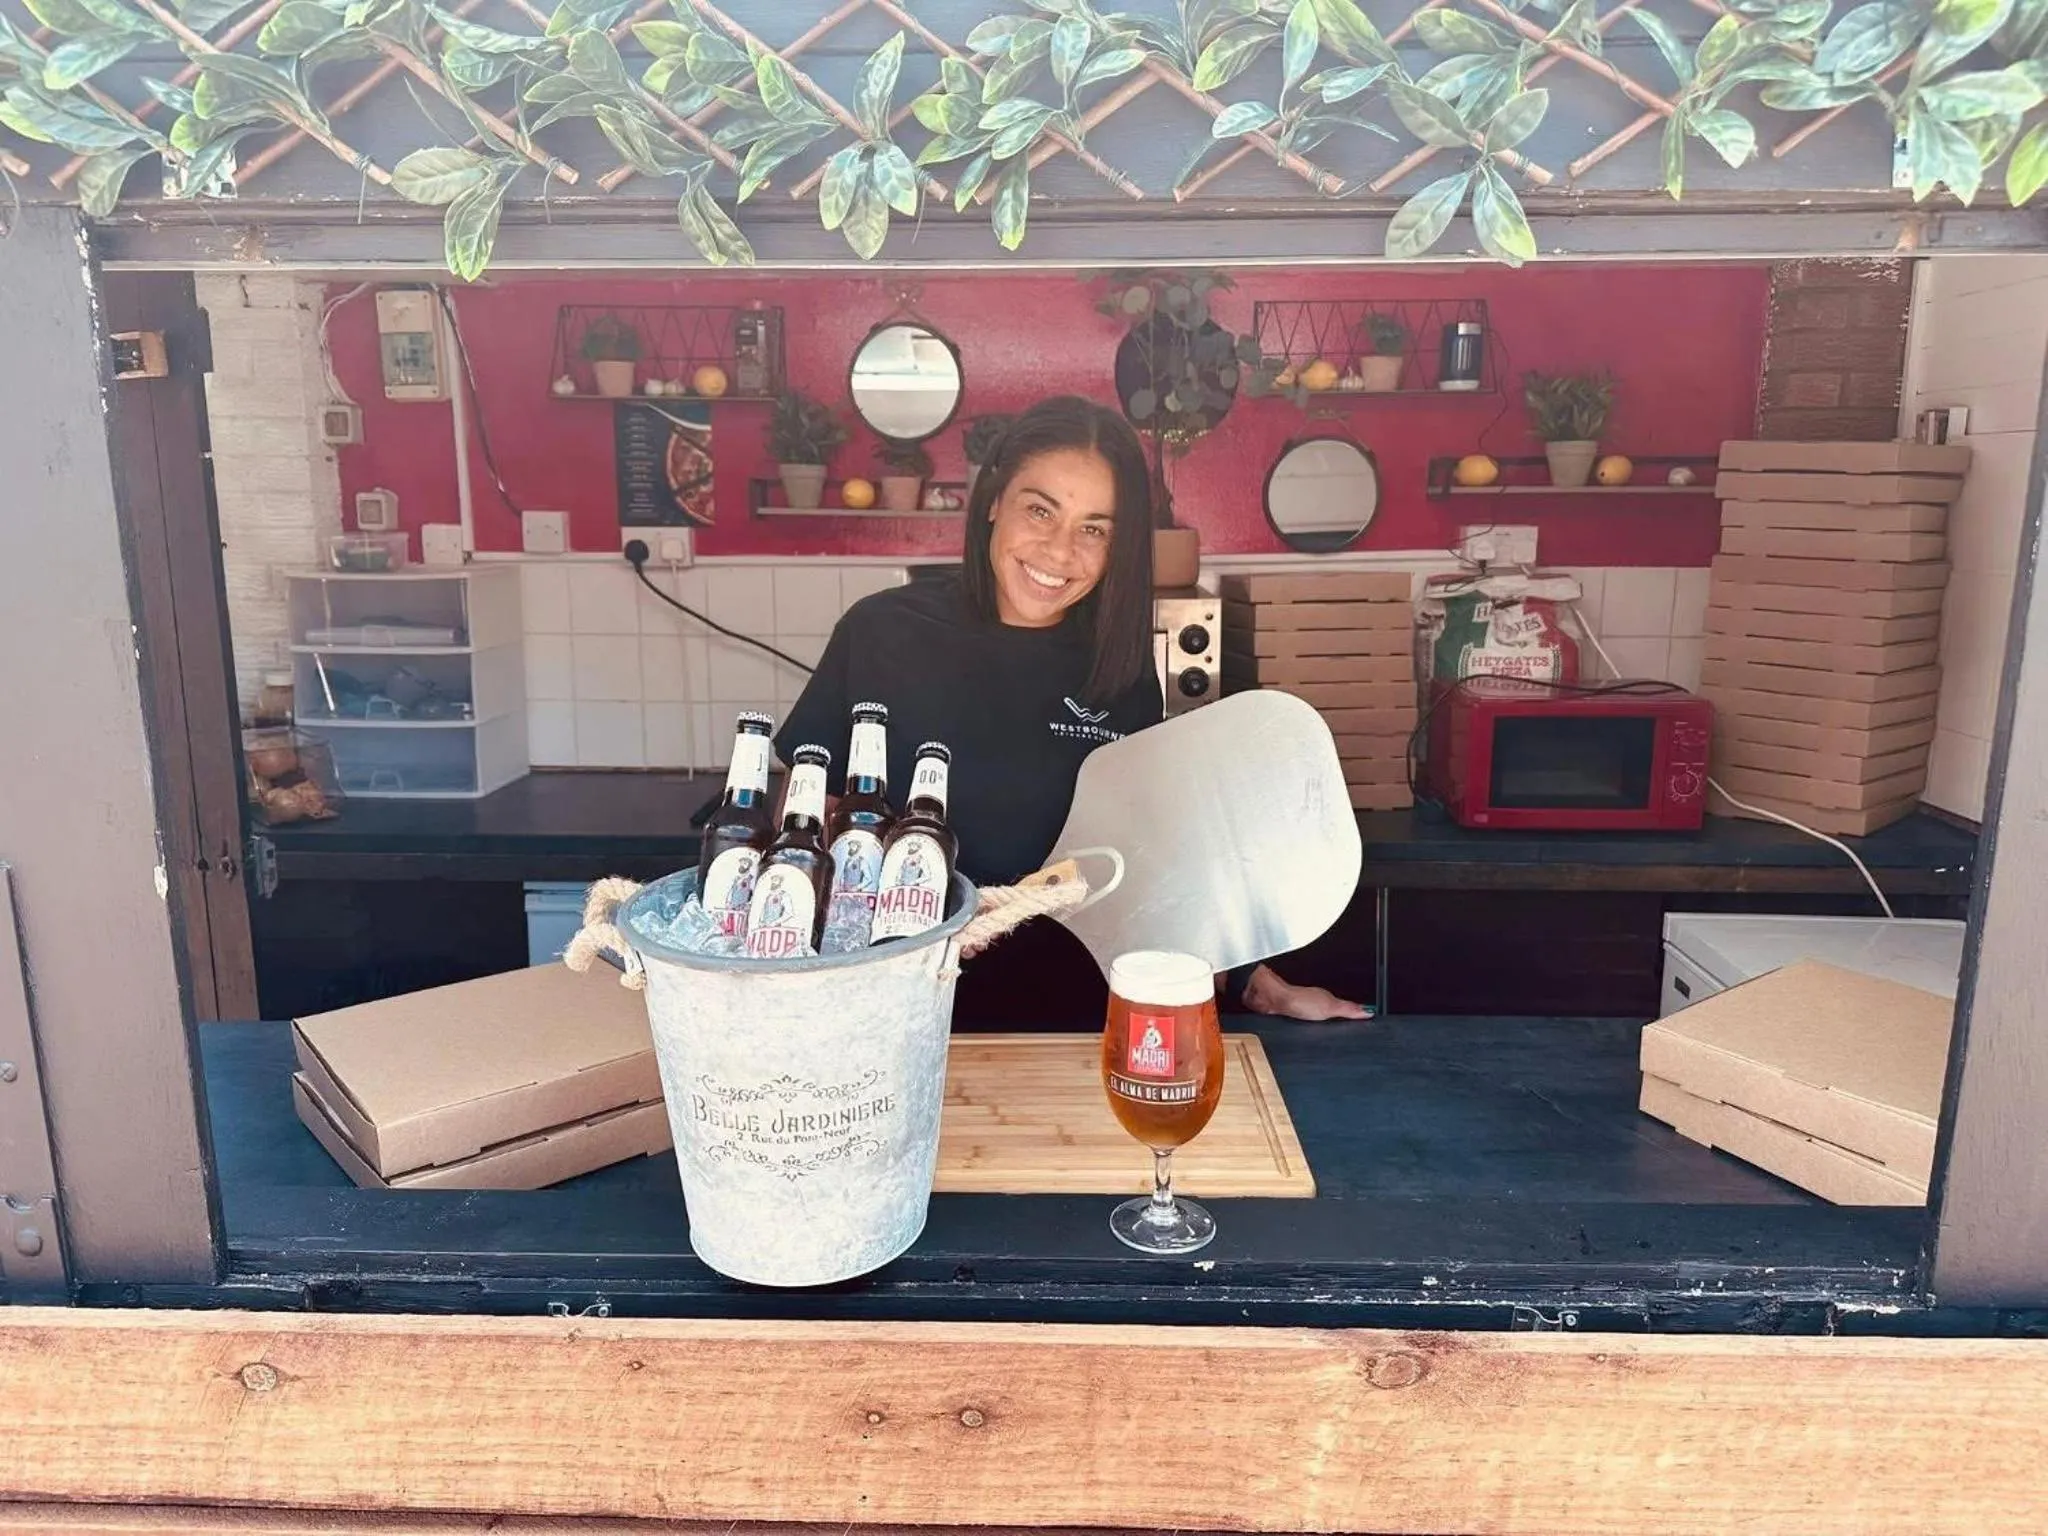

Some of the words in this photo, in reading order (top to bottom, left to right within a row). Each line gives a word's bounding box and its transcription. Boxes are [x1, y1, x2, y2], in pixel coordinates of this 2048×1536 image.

[1471, 656, 1550, 667] HEYGATES
[1490, 667, 1533, 677] PIZZA
[1120, 1080, 1142, 1098] ALMA
[1146, 1086, 1157, 1100] DE
[692, 1093, 761, 1133] BELLE
[737, 1131, 744, 1142] 2
[751, 1133, 773, 1144] Rue
[777, 1135, 790, 1145] du
